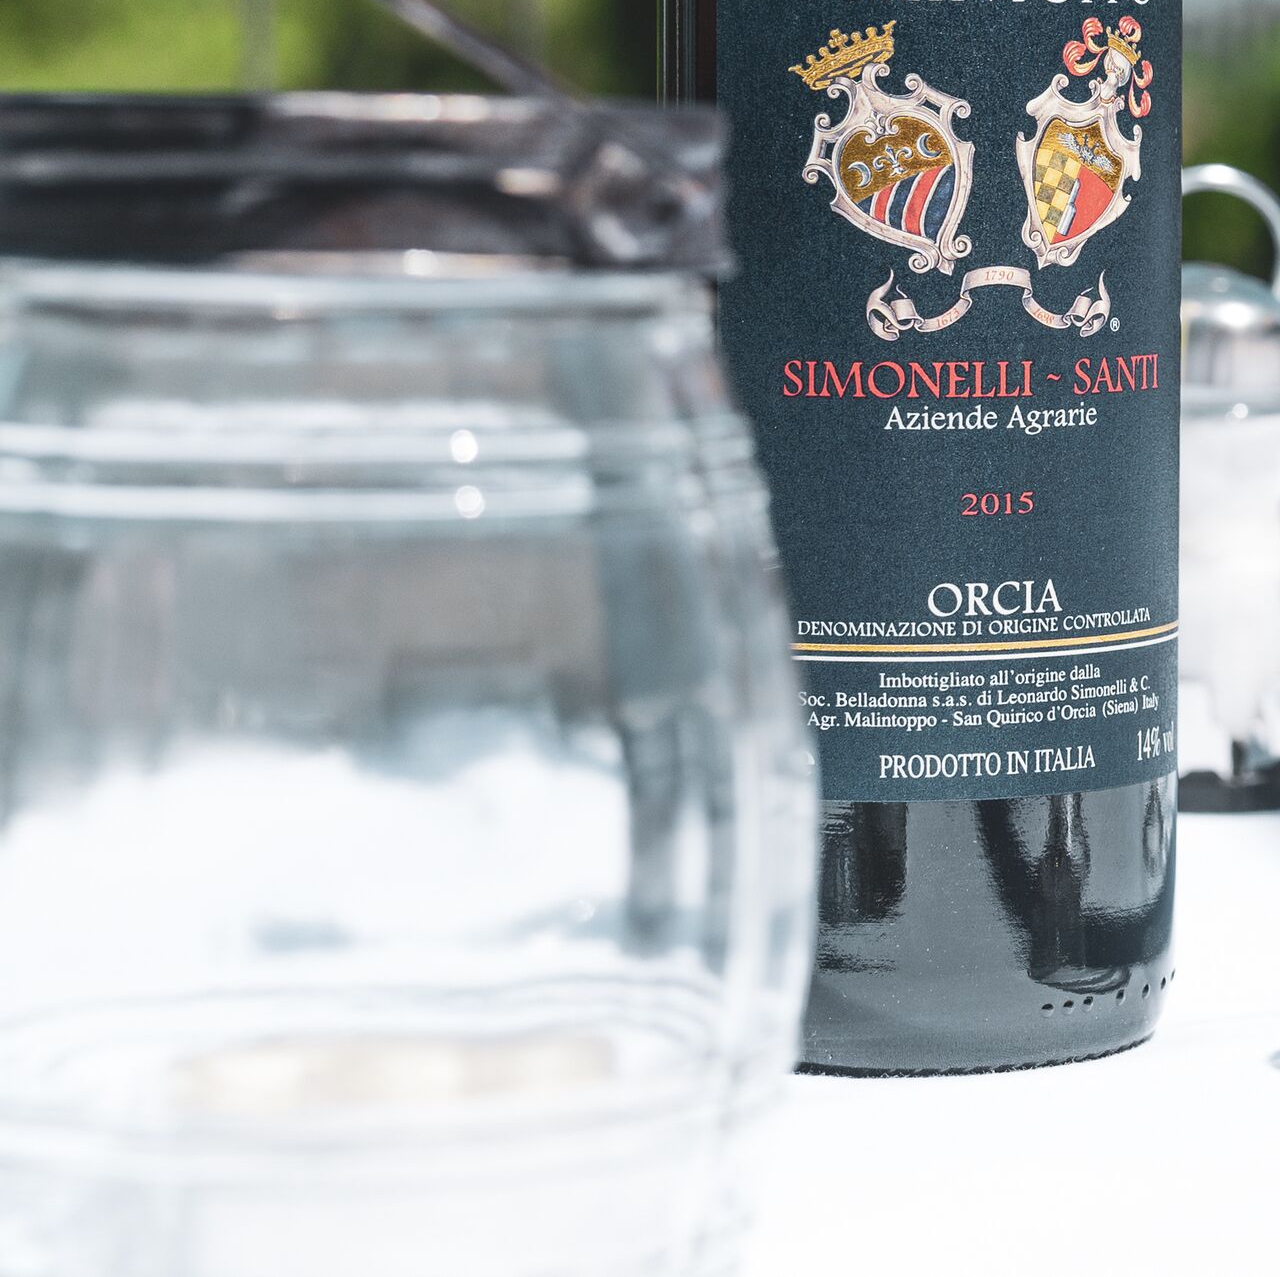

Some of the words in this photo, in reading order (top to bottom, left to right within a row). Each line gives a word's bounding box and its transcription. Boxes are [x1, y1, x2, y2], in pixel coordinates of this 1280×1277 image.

[984, 270, 1014, 282] 1790
[783, 360, 1034, 399] SIMONELLI
[1073, 354, 1160, 394] SANTI
[884, 405, 997, 431] Aziende
[1006, 401, 1099, 435] Agrarie
[961, 491, 1035, 517] 2015
[928, 579, 1063, 617] ORCIA
[797, 620, 957, 637] DENOMINAZIONE
[962, 620, 983, 635] DI
[988, 616, 1059, 635] ORIGINE
[1062, 607, 1151, 631] CONTROLLATA
[798, 691, 831, 707] Soc.
[835, 691, 928, 708] Belladonna
[932, 694, 973, 707] s.a.s.
[976, 689, 992, 706] di
[998, 685, 1068, 705] Leonardo
[1070, 679, 1127, 700] Simonelli
[1129, 677, 1138, 693] &
[1140, 674, 1151, 691] C.
[879, 672, 985, 691] Imbottigliato
[1069, 664, 1100, 680] dalla
[807, 711, 841, 730] Agr.
[844, 712, 938, 731] Malintoppo
[952, 710, 982, 726] San
[986, 708, 1043, 727] Quirico
[1102, 697, 1139, 718] (Siena)
[1142, 692, 1160, 711] Italy
[1137, 725, 1161, 761] 14%
[879, 752, 1000, 779] PRODOTTO
[1006, 750, 1028, 774] IN
[1033, 744, 1096, 773] ITALIA
